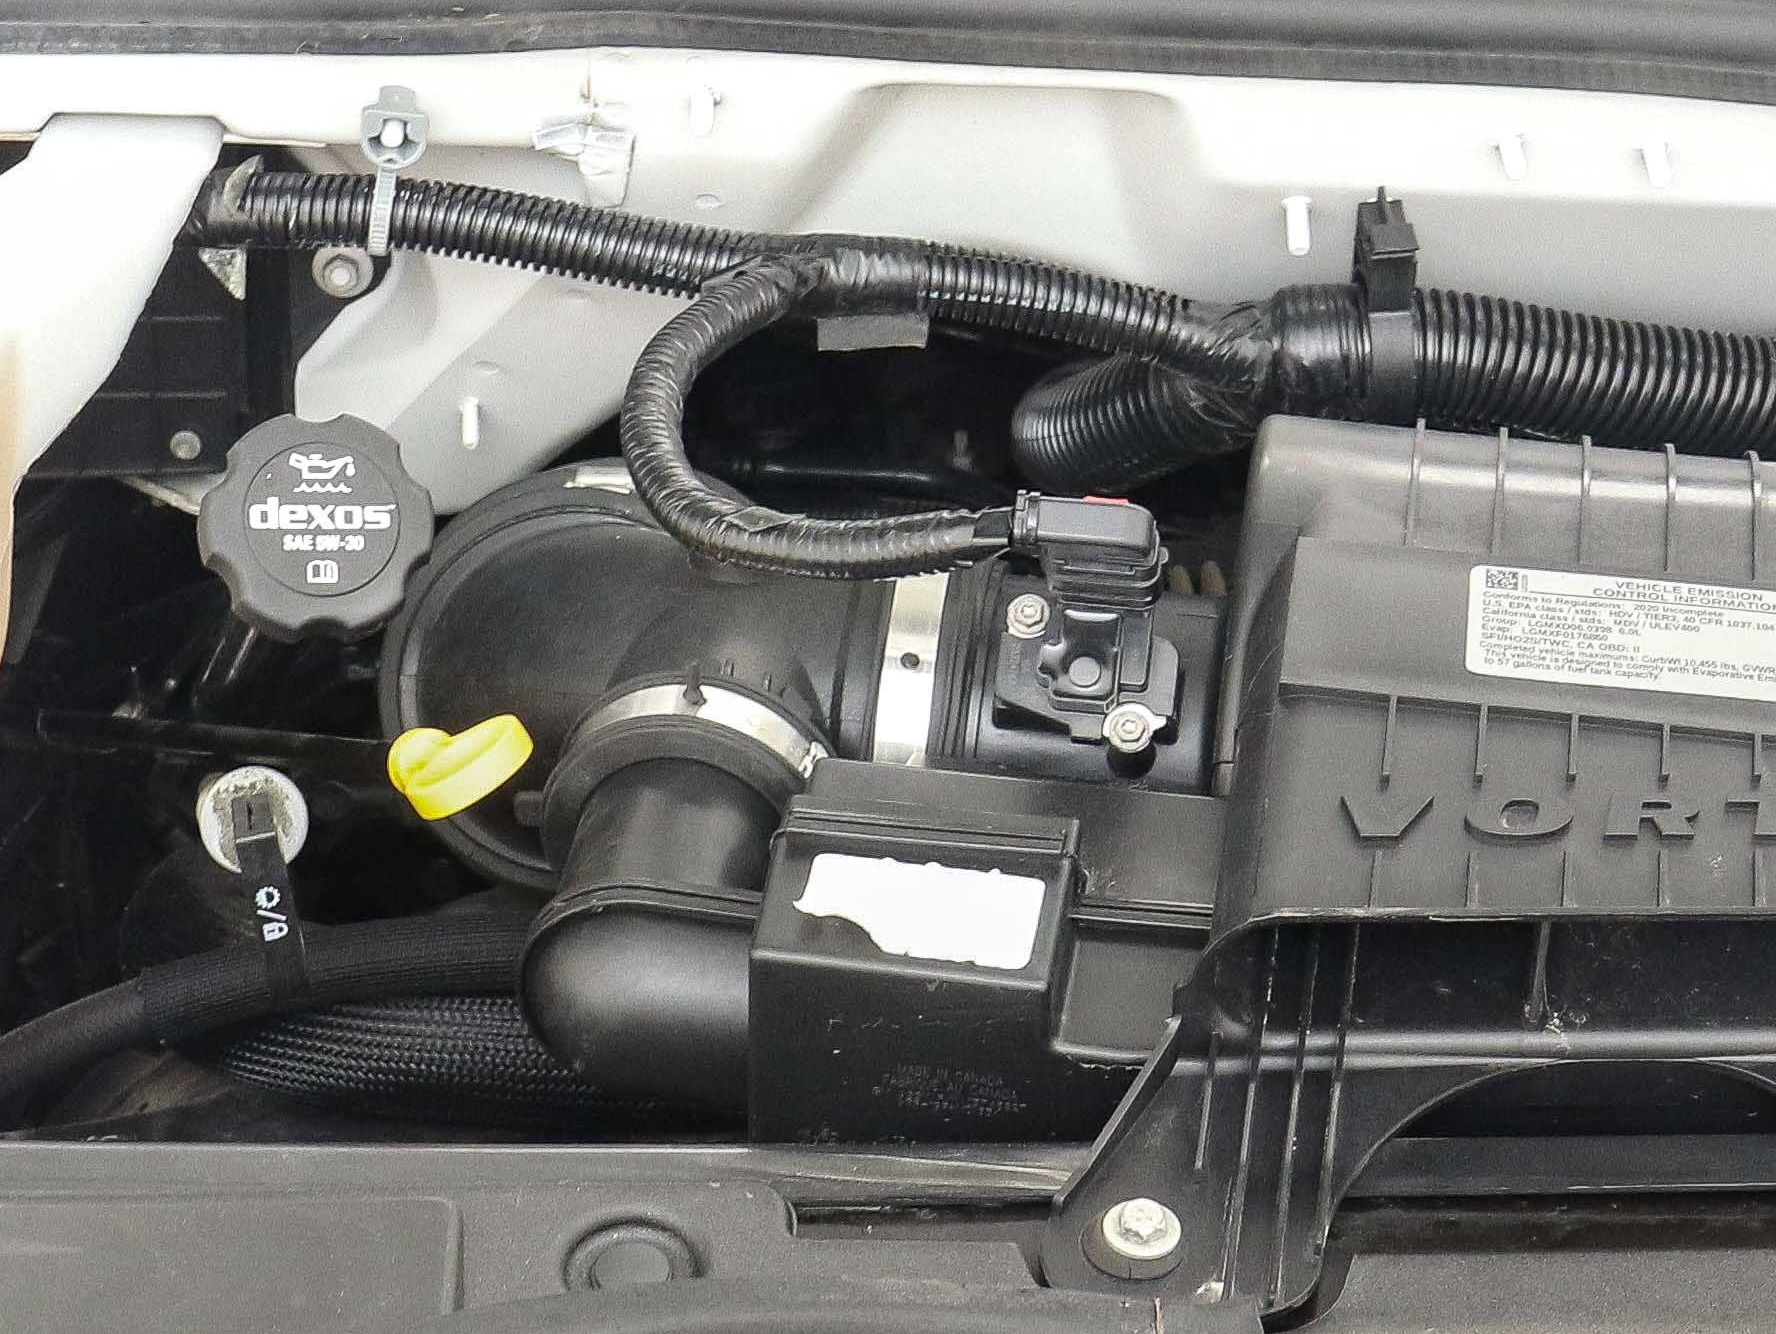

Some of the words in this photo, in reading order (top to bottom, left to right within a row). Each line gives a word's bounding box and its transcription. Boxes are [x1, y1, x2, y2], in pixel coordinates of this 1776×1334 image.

[249, 497, 396, 529] dexos
[283, 534, 314, 551] SAE
[1593, 588, 1669, 601] CONTROL
[1616, 581, 1681, 594] VEHICLE
[1688, 587, 1763, 601] EMISSION
[1483, 591, 1538, 603] Conforms
[1542, 596, 1552, 604] to
[1556, 597, 1624, 609] Regulations:
[1634, 603, 1659, 612] 2020
[1482, 607, 1536, 619] California
[1509, 601, 1531, 610] EPA
[1699, 617, 1723, 626] CFR
[1577, 641, 1594, 649] CA
[1479, 640, 1536, 653] Completed
[1539, 647, 1574, 656] vehicle
[1742, 664, 1776, 674] GVWR
[1484, 657, 1494, 665] to
[1513, 660, 1551, 671] gallons
[1568, 664, 1587, 673] fuel
[1591, 666, 1612, 675] tank
[1486, 648, 1506, 658] This
[1510, 652, 1546, 661] vehicle
[1562, 657, 1610, 668] designed
[1613, 661, 1623, 669] to
[1626, 663, 1664, 674] comply
[1667, 665, 1689, 675] with
[1693, 667, 1754, 680] Evaporative
